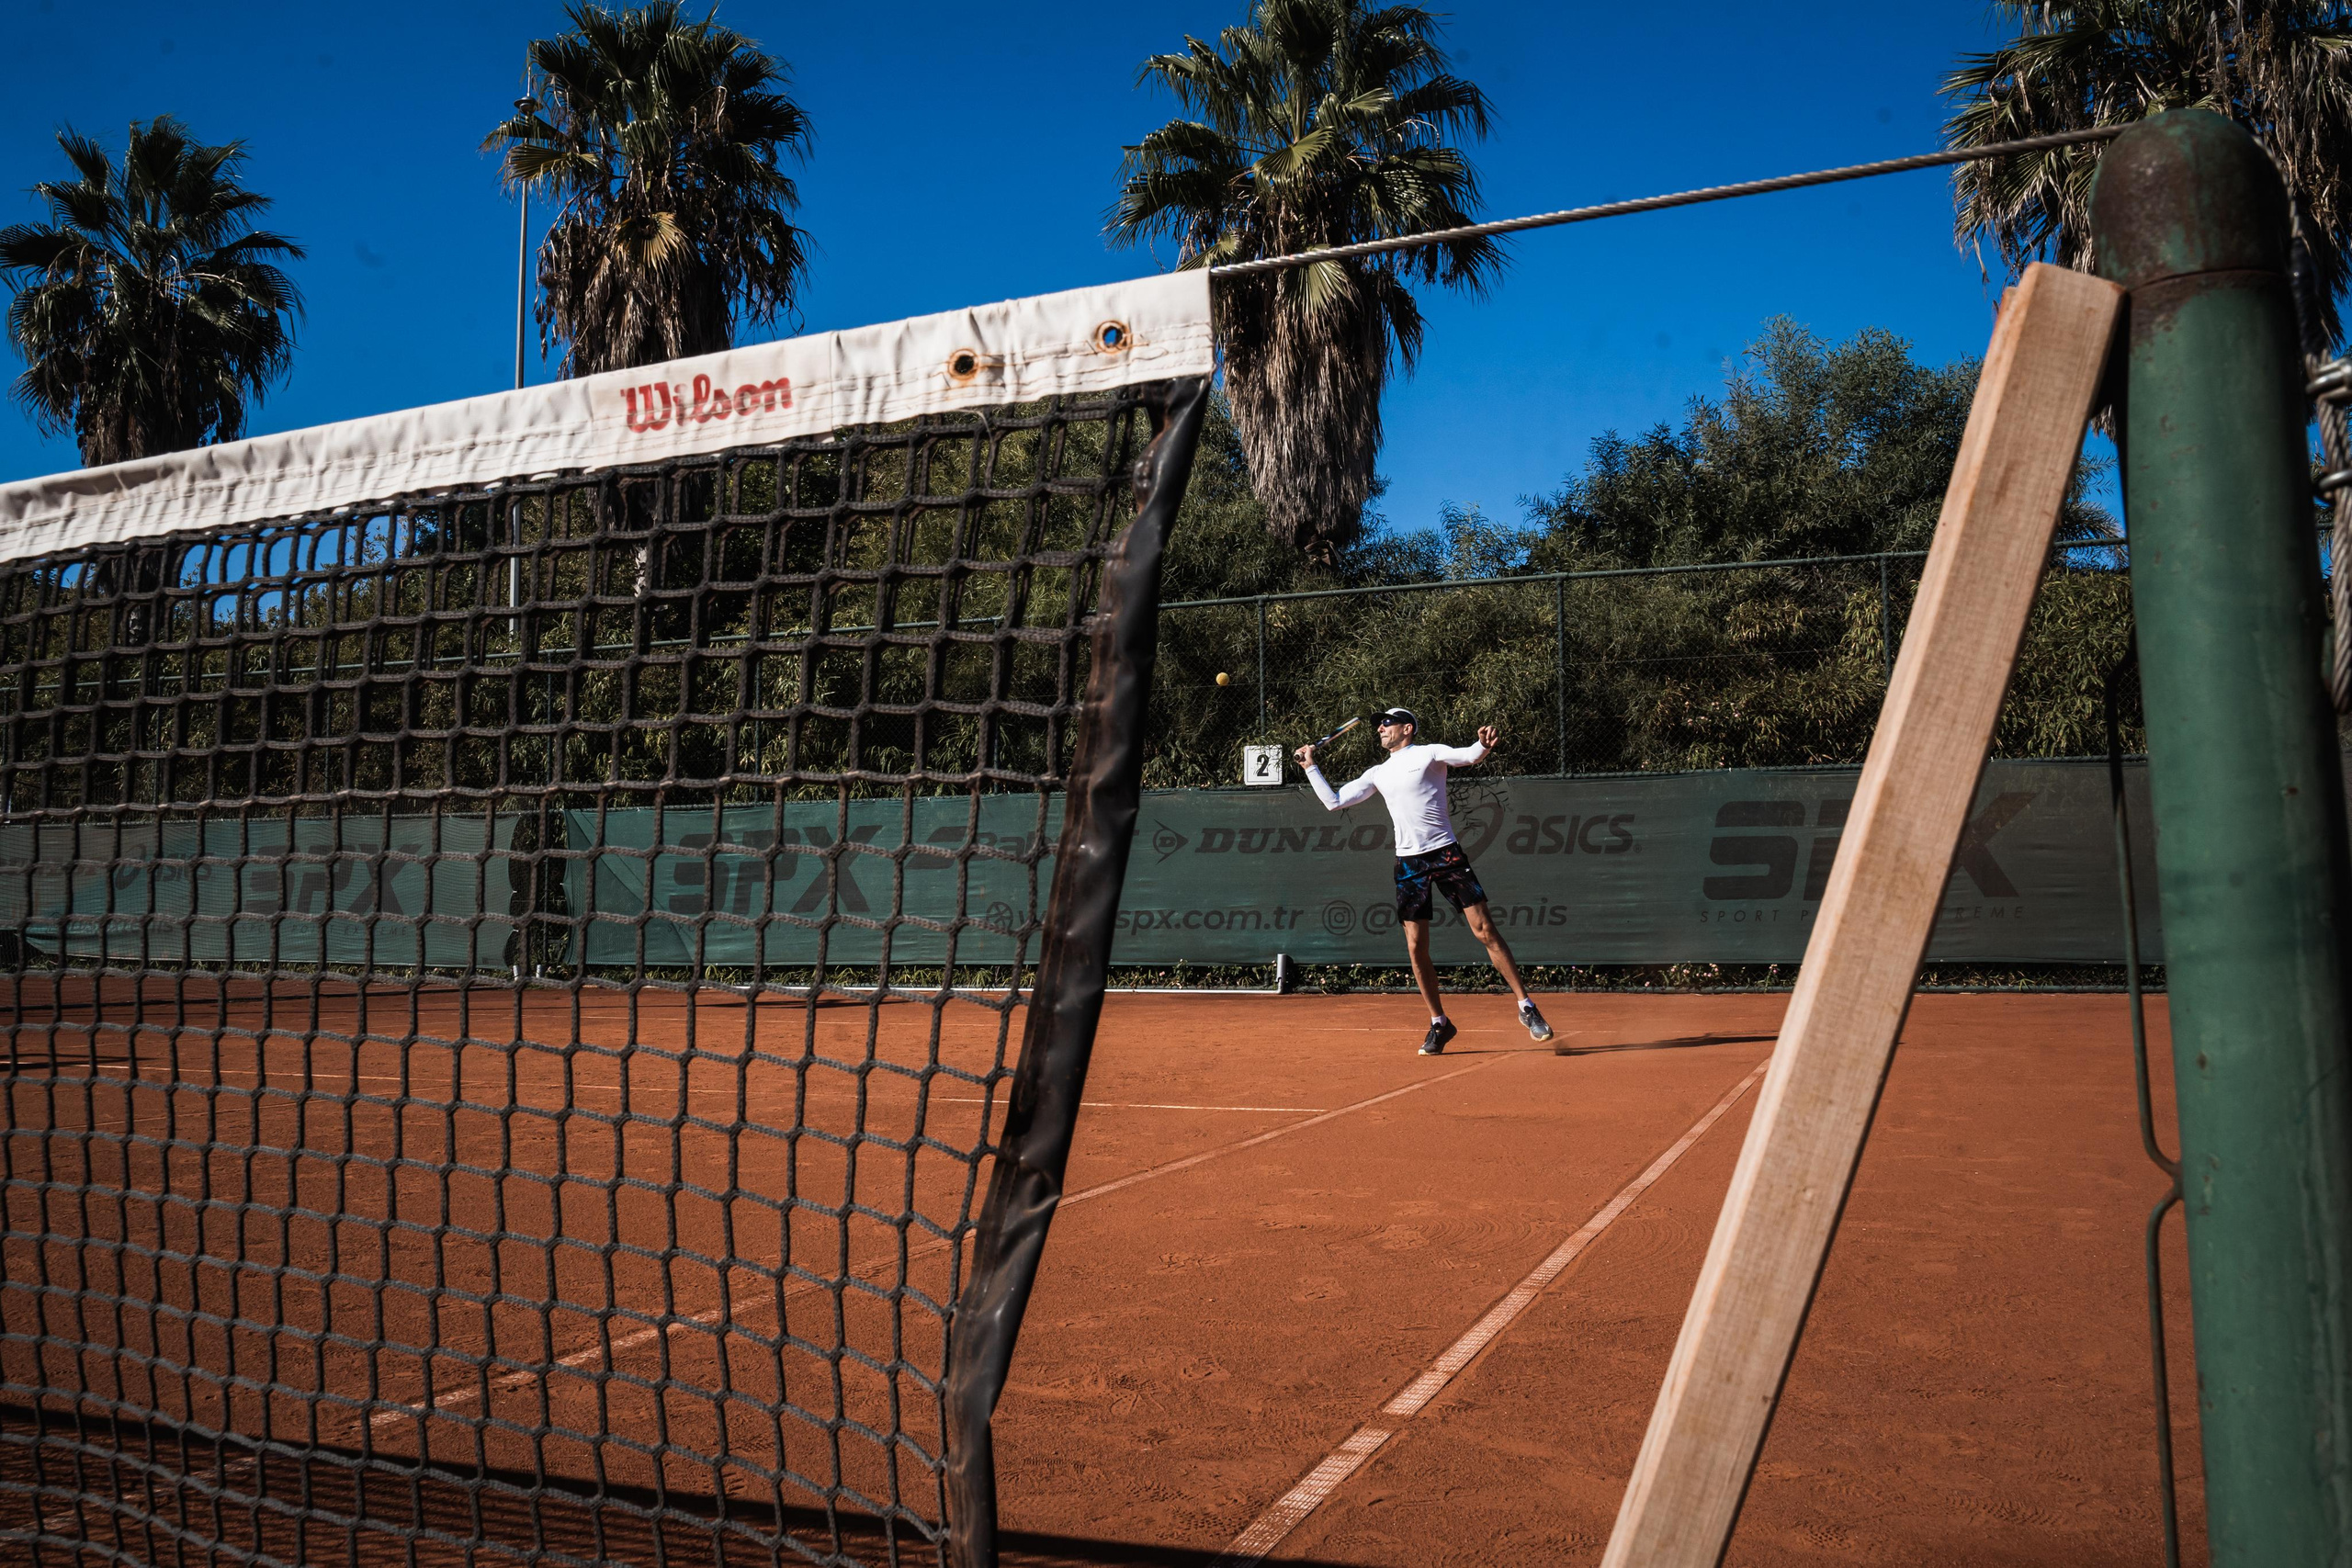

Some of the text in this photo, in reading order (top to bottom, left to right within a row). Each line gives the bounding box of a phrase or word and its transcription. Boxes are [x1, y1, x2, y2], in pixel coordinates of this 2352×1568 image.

[620, 373, 794, 434] Wilson
[1256, 753, 1270, 777] 2
[1194, 824, 1396, 853] DUNLO
[244, 843, 424, 916] SPX
[669, 825, 885, 916] SPX
[1700, 909, 1780, 922] SPORT
